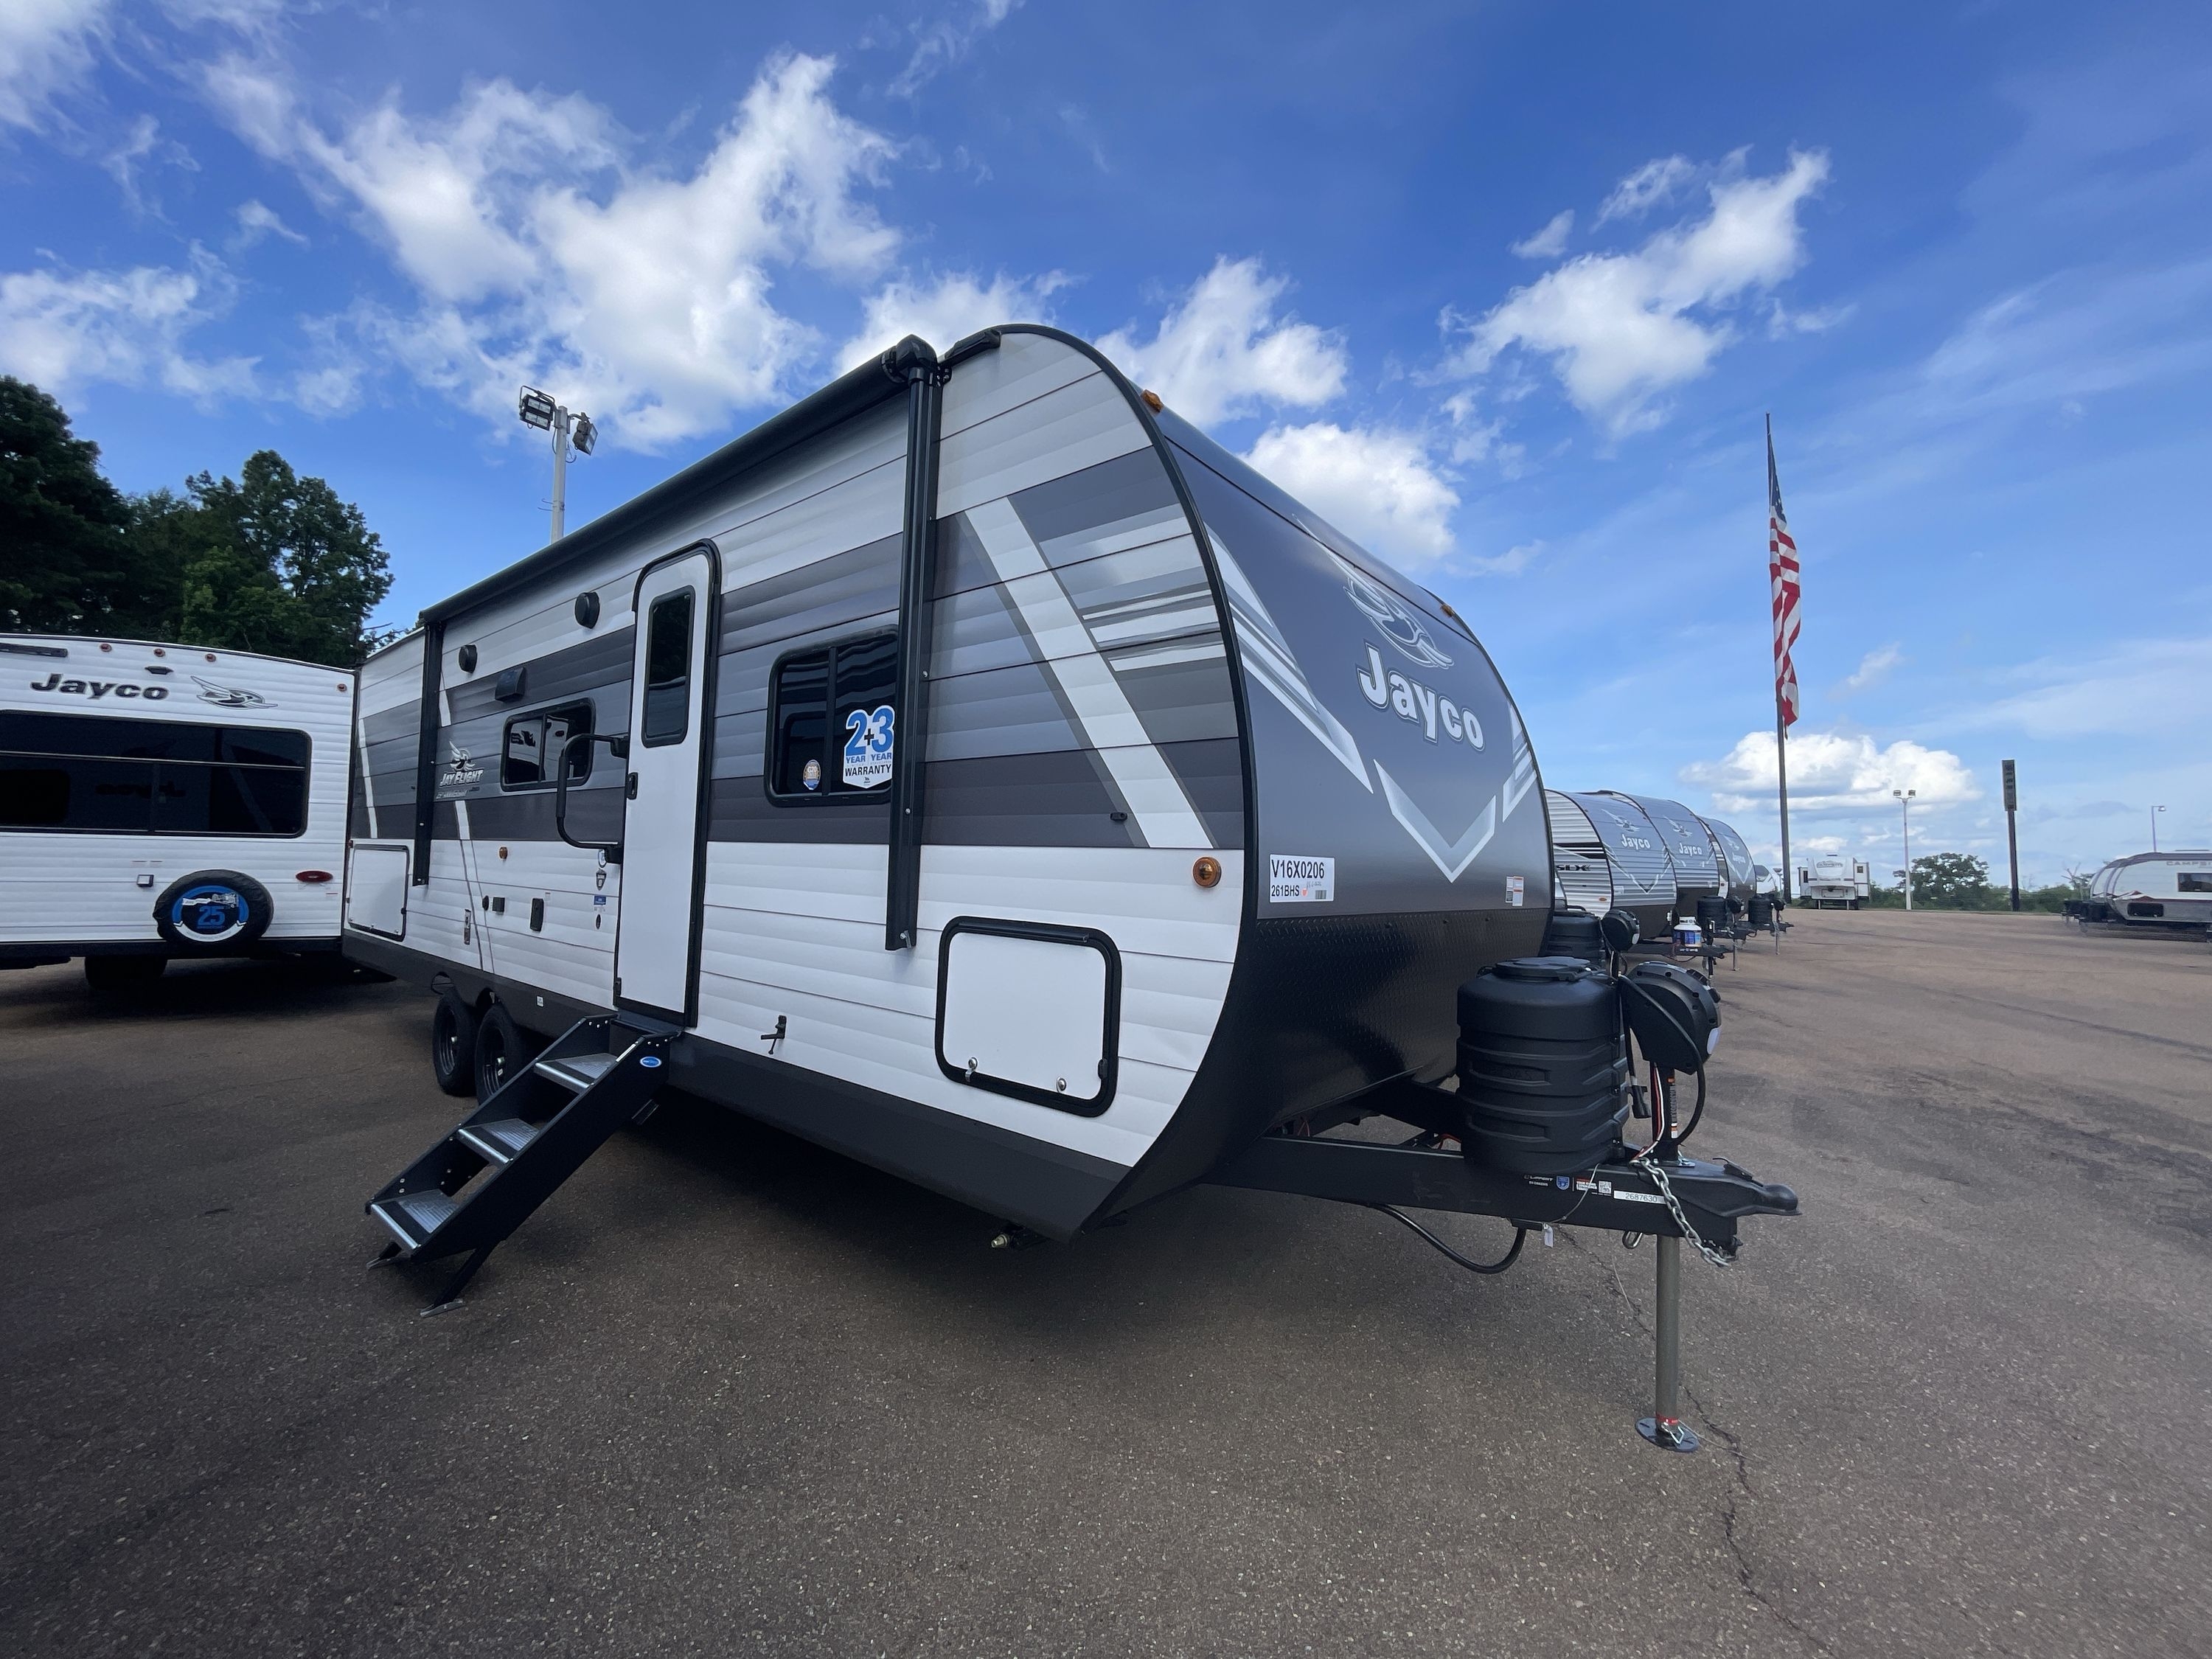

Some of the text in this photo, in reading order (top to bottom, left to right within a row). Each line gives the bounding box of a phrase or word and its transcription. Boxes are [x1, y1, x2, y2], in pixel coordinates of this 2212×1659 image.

[30, 673, 169, 700] Jayco
[1358, 641, 1484, 751] Jayco
[871, 753, 891, 761] YEAR
[439, 769, 484, 786] JAY FLIGHT
[845, 764, 891, 776] WARRANTY
[1621, 833, 1650, 850] Jayco
[1679, 842, 1702, 857] Jayco
[1271, 859, 1324, 879] V16X0206
[1271, 885, 1300, 897] 261BHS
[198, 905, 225, 925] 25
[1625, 1192, 1658, 1202] 2687630
